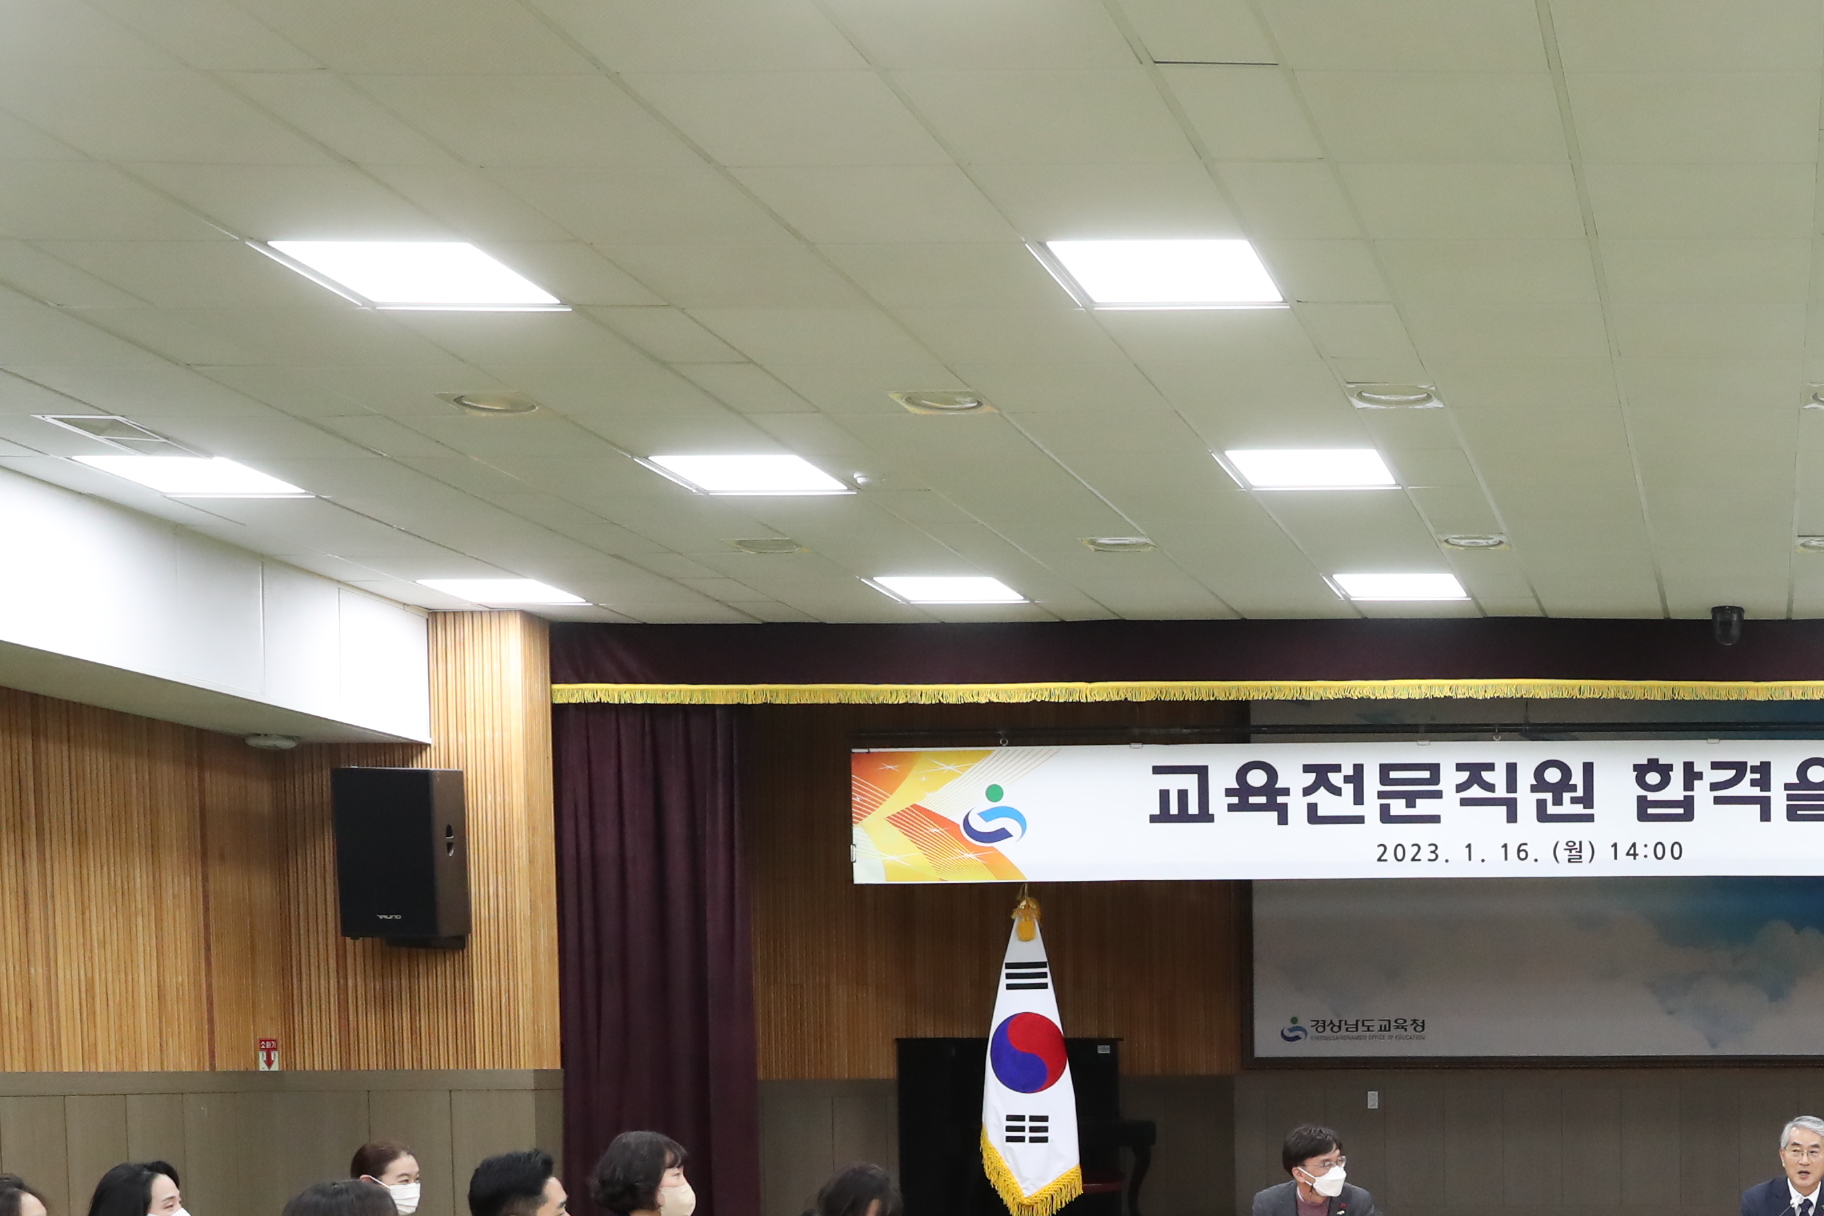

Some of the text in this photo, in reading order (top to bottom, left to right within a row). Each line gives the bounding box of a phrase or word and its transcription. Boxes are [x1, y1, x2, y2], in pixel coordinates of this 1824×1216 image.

[1149, 759, 1595, 826] 교육전문직원
[1376, 840, 1684, 865] 2023. 1. 16. (월) 14:00
[1310, 1017, 1426, 1034] 경상남도교육청
